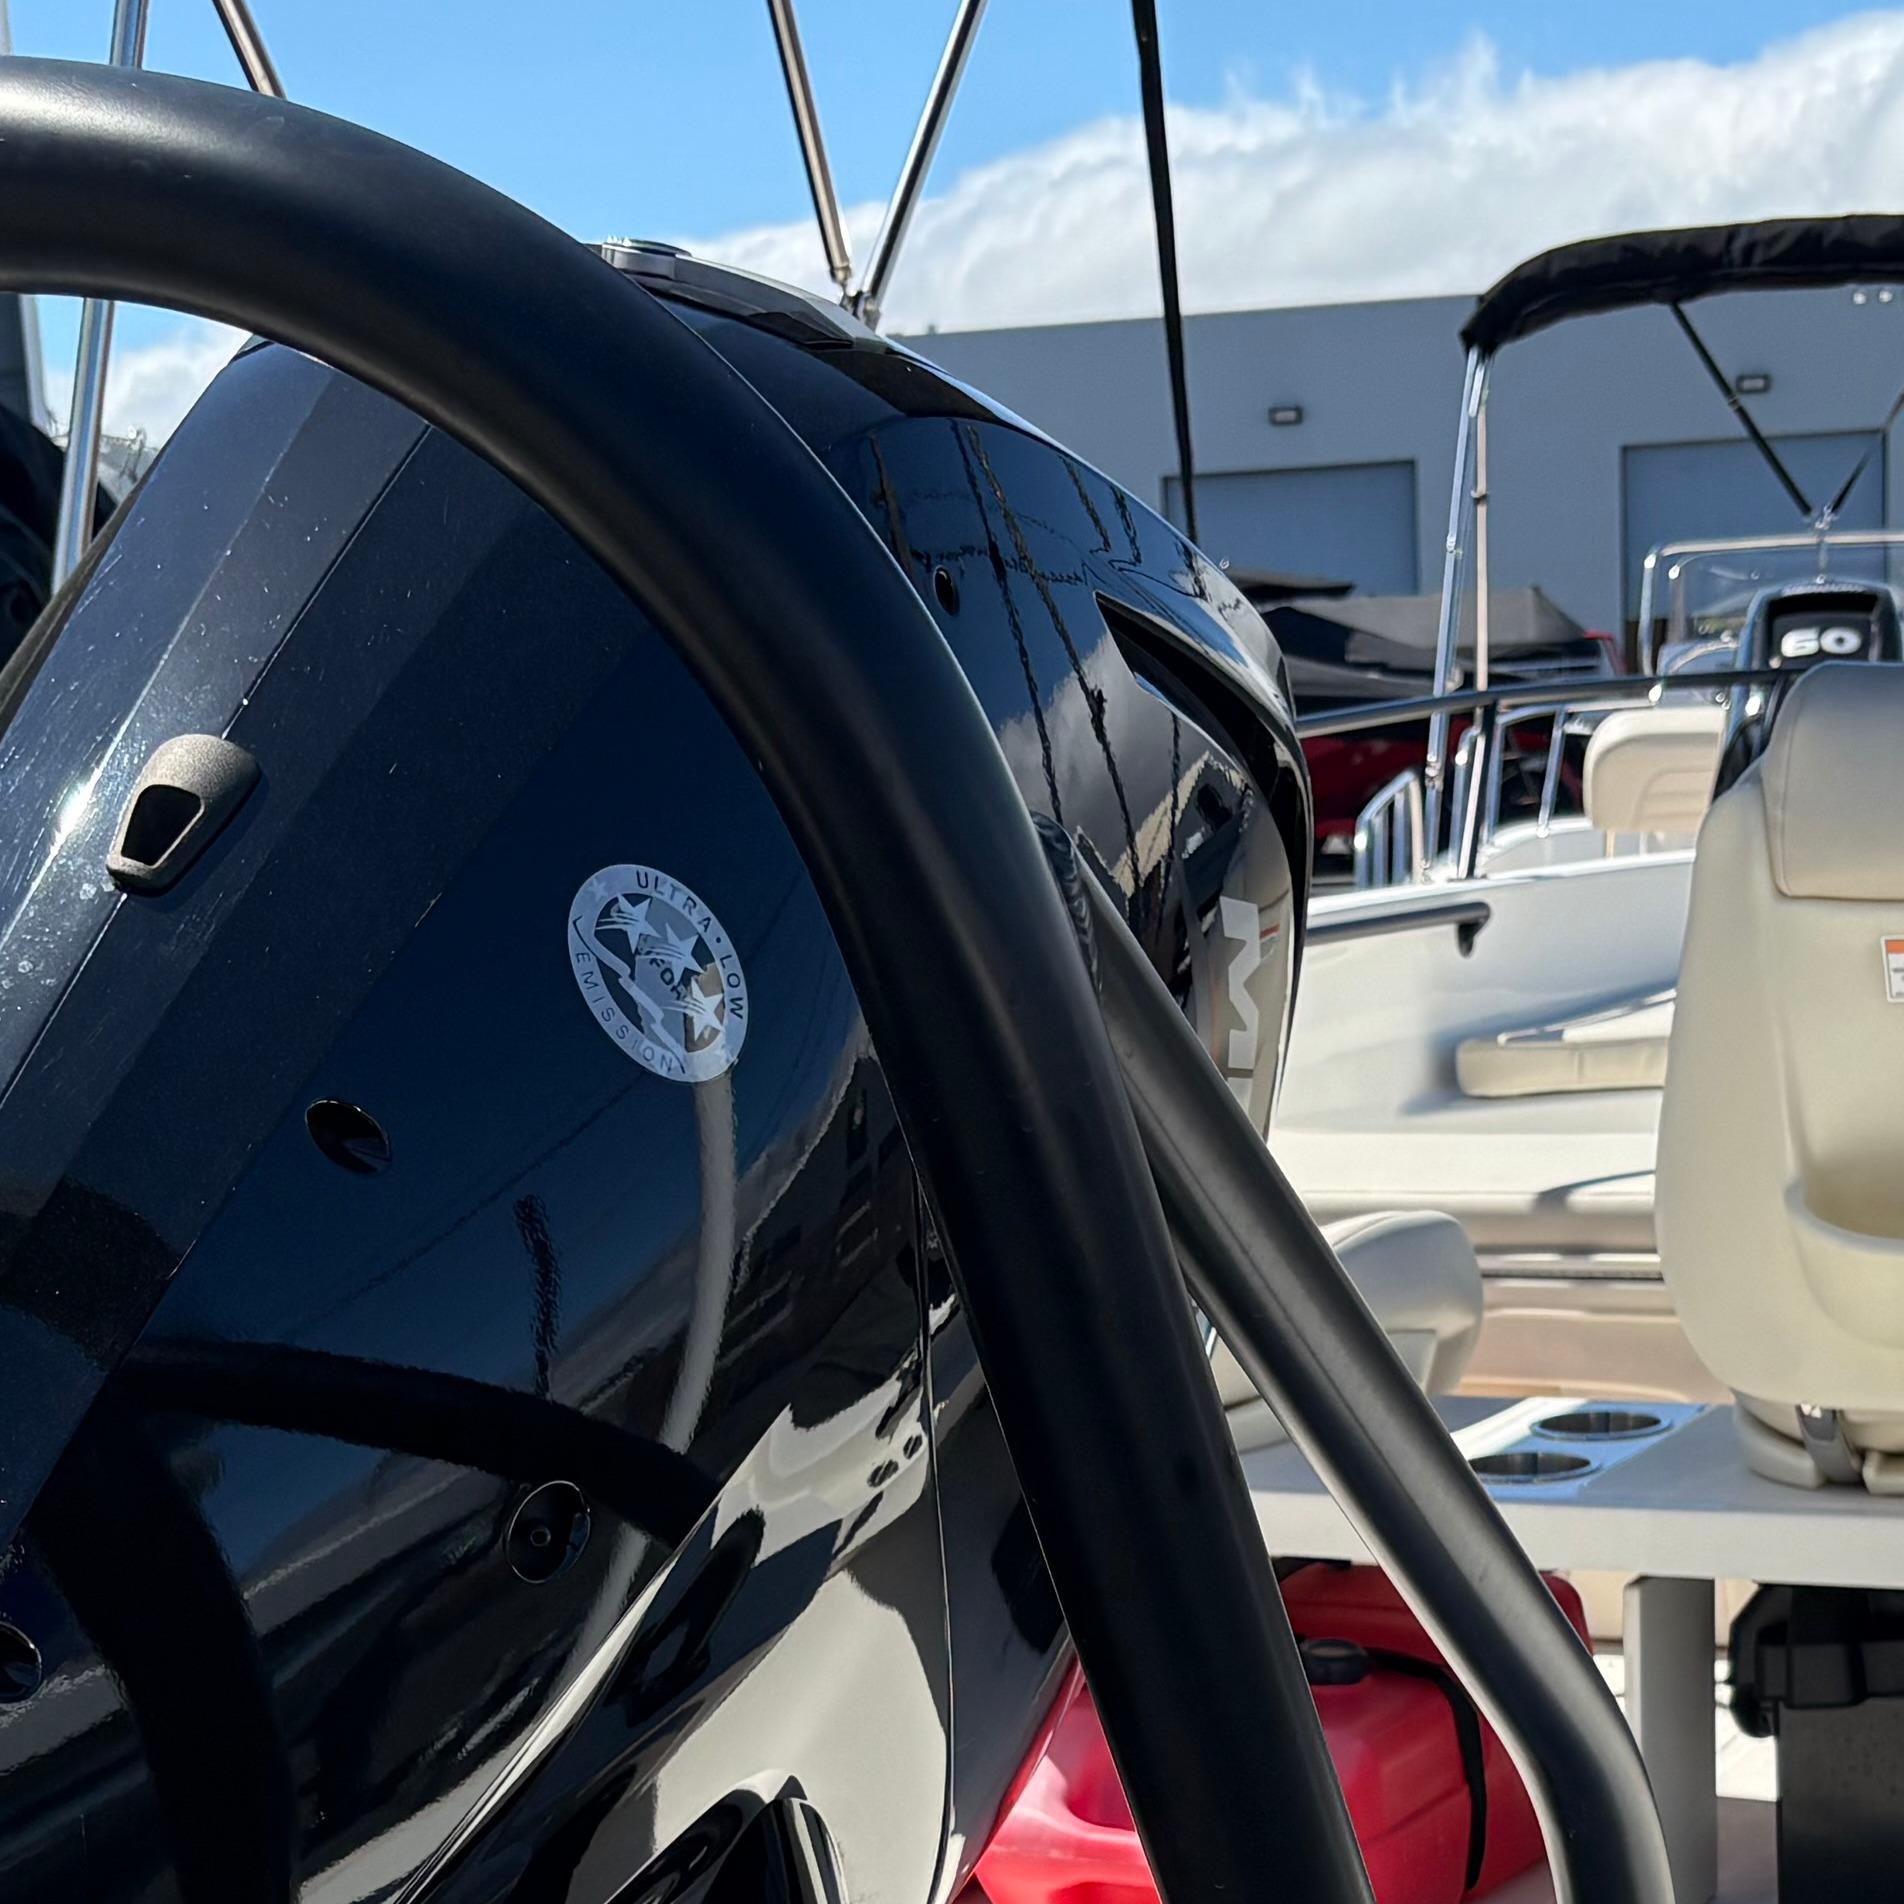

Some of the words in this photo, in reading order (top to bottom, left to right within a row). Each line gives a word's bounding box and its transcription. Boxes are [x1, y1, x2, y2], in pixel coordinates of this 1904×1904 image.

[1781, 627, 1862, 658] 60
[636, 870, 713, 933] ULTRA
[719, 954, 744, 1020] LOW
[575, 952, 674, 1074] EMISSION
